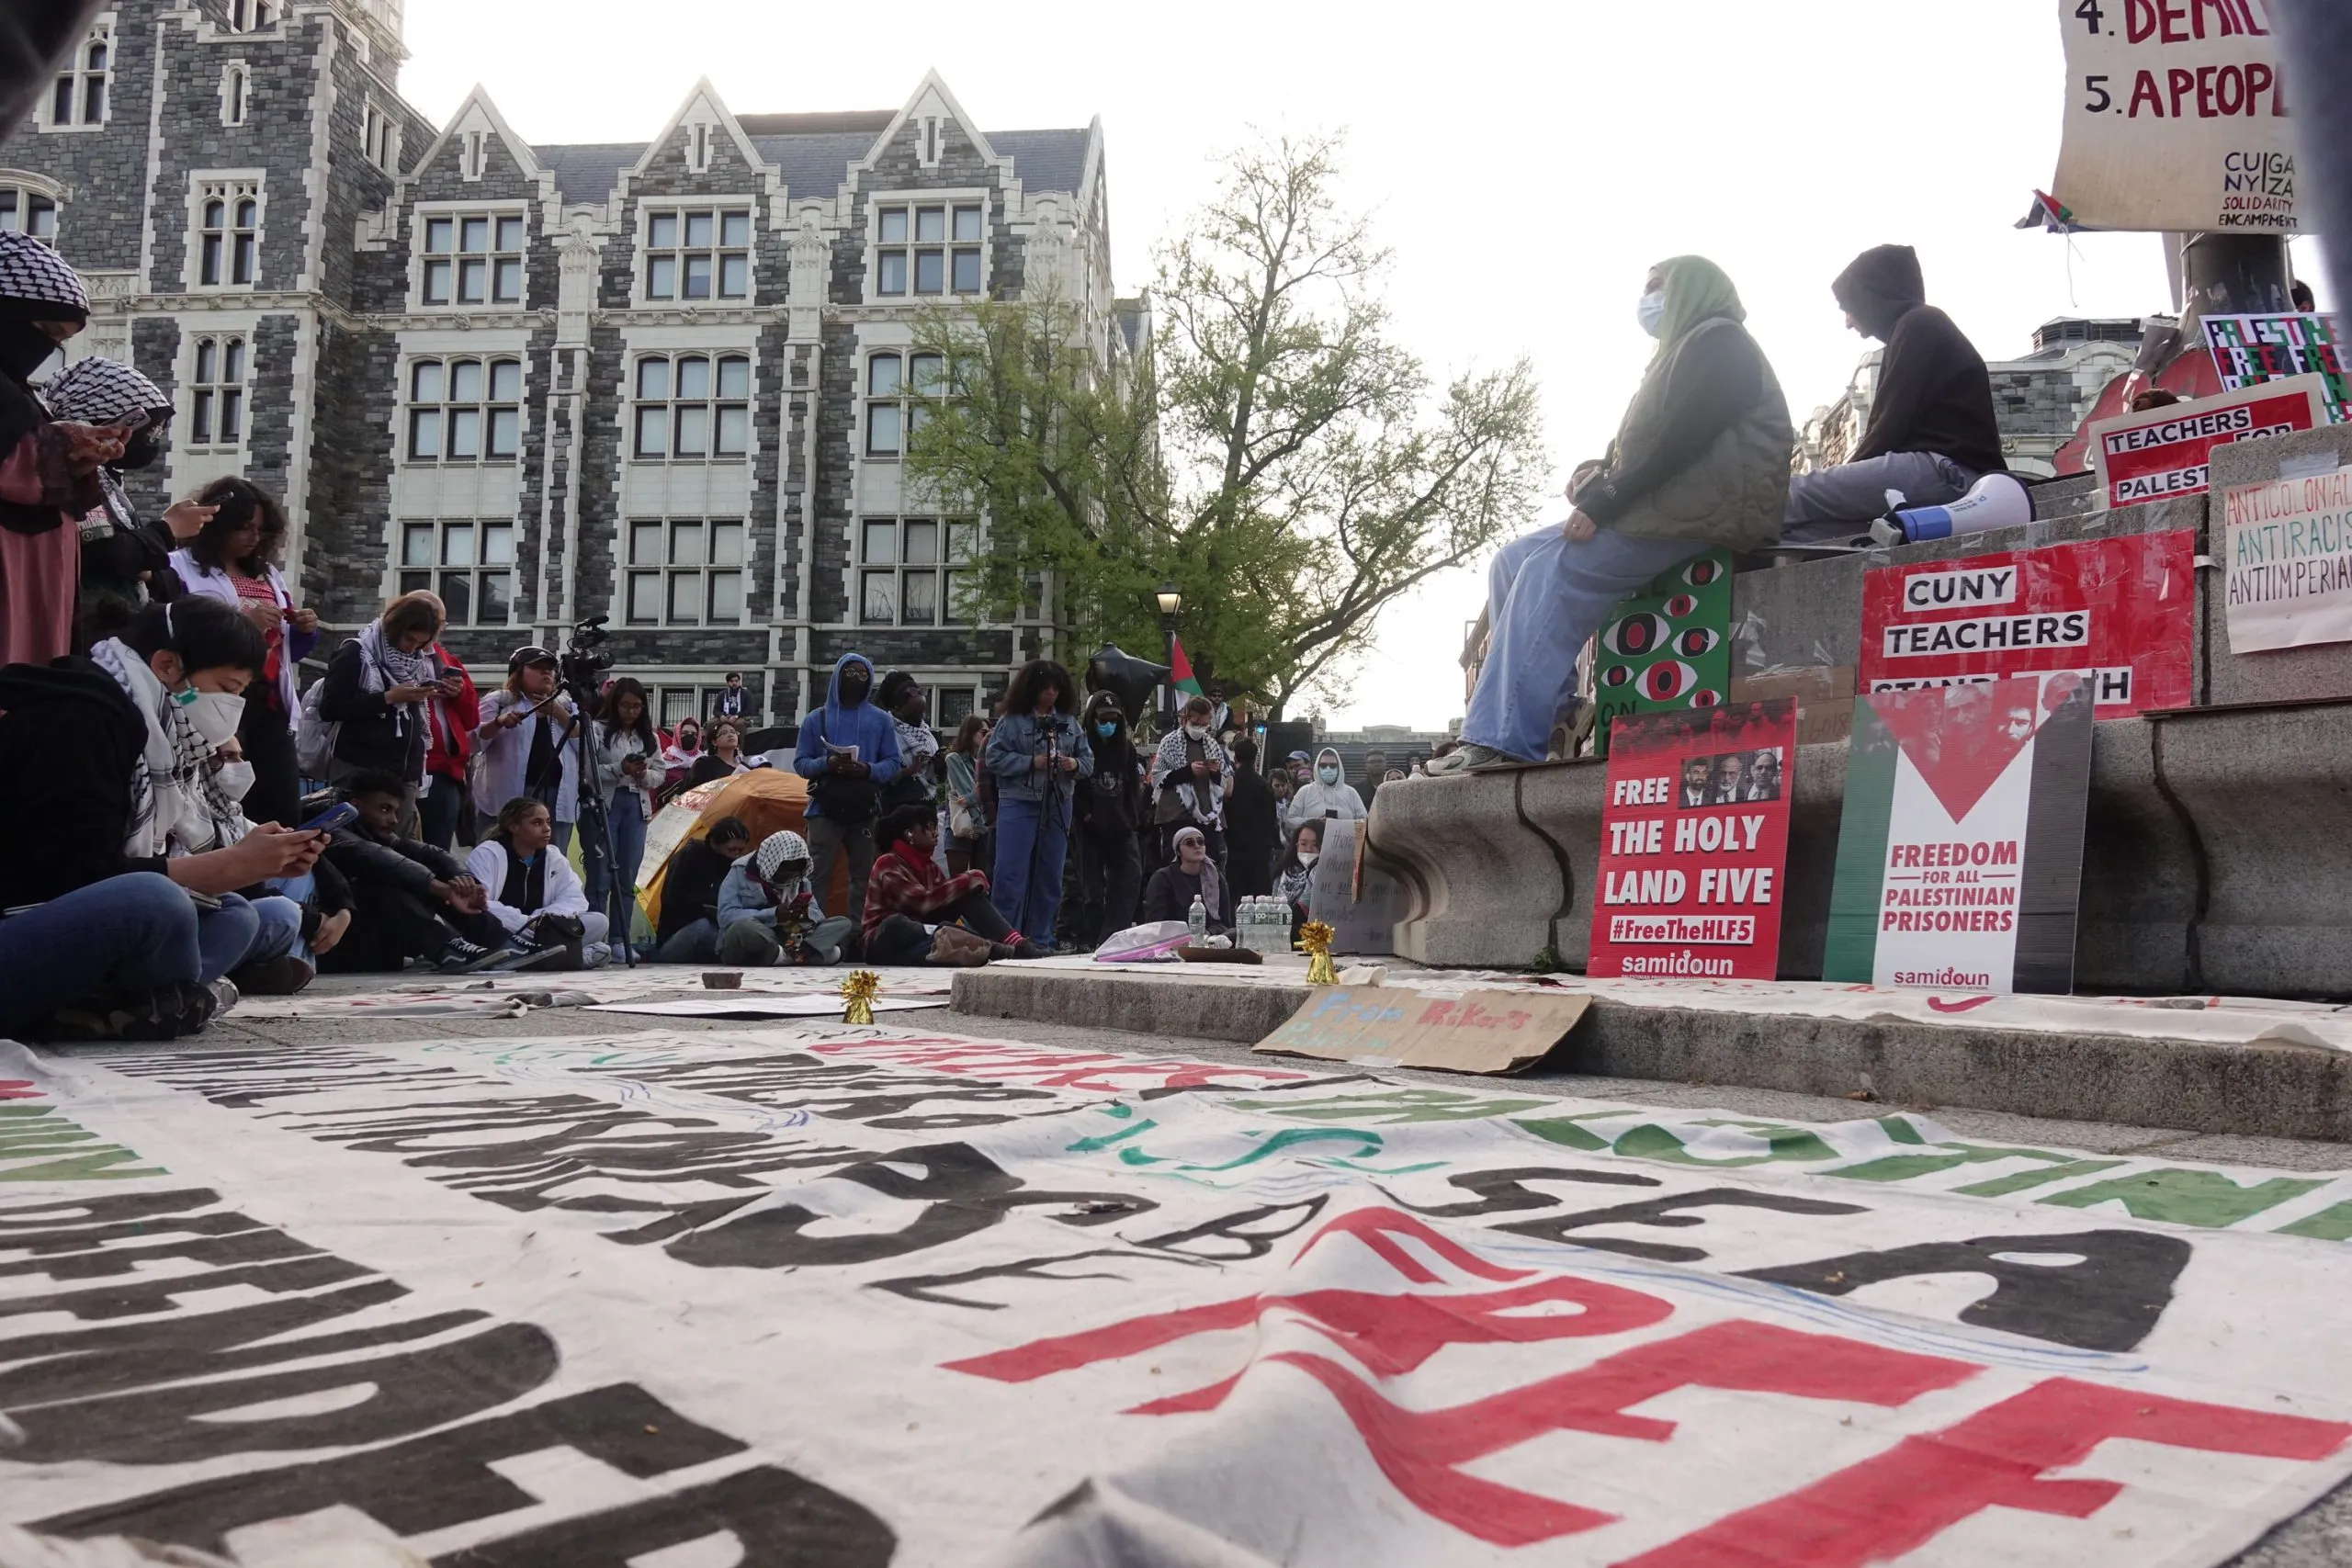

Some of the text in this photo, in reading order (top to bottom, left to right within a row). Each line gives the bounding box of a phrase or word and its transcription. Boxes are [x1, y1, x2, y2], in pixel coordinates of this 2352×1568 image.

[2075, 0, 2115, 36] 4.
[2084, 75, 2123, 115] 5.
[2128, 70, 2165, 118] A
[2222, 196, 2293, 212] SOLIDARITY
[2218, 212, 2298, 228] ENCAMPMENT
[2213, 344, 2285, 378] FREE
[2108, 409, 2249, 453] TEACHERS
[2227, 473, 2352, 526] ANTICOLONIAL
[1907, 570, 2012, 606] CUNY
[1887, 614, 2085, 654] TEACHERS
[1613, 777, 1670, 807] FREE
[1610, 815, 1765, 855] THE HOLY
[1890, 840, 2018, 868] FREEDOM
[1603, 867, 1773, 905] LAND FIVE
[1922, 870, 1980, 884] FOR ALL
[1884, 886, 2016, 907] PALESTINIAN
[1612, 919, 1750, 942] #FreeTheHLF5
[1883, 909, 2013, 932] PRISONERS
[1622, 950, 1734, 976] samidoun
[1894, 967, 1989, 987] samidoun
